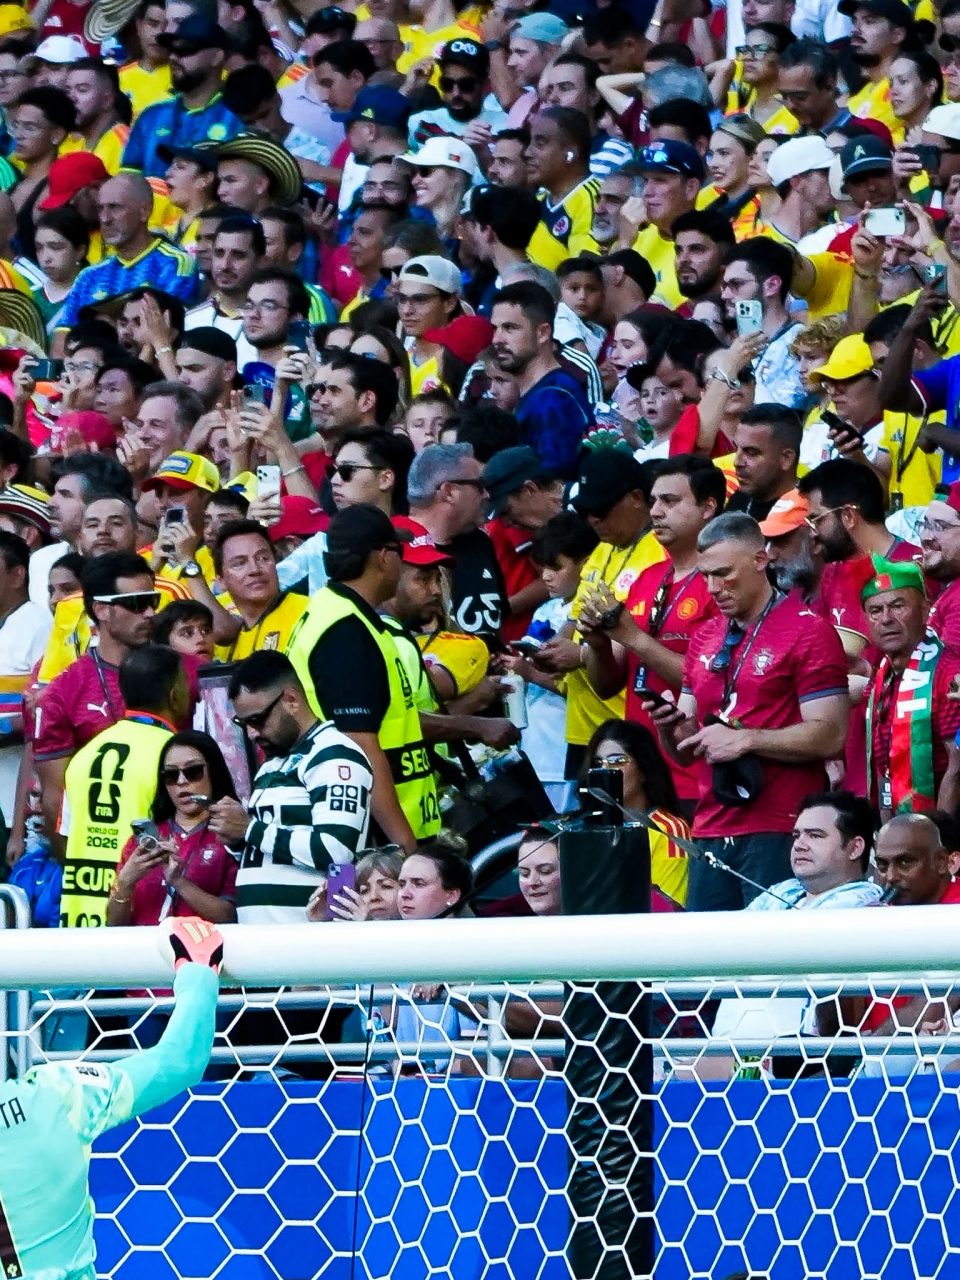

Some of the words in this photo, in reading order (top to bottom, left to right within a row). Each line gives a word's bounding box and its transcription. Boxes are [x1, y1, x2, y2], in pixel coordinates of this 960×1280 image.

[87, 826, 107, 835] WORLD
[108, 828, 119, 836] CUP
[86, 836, 118, 849] 2026
